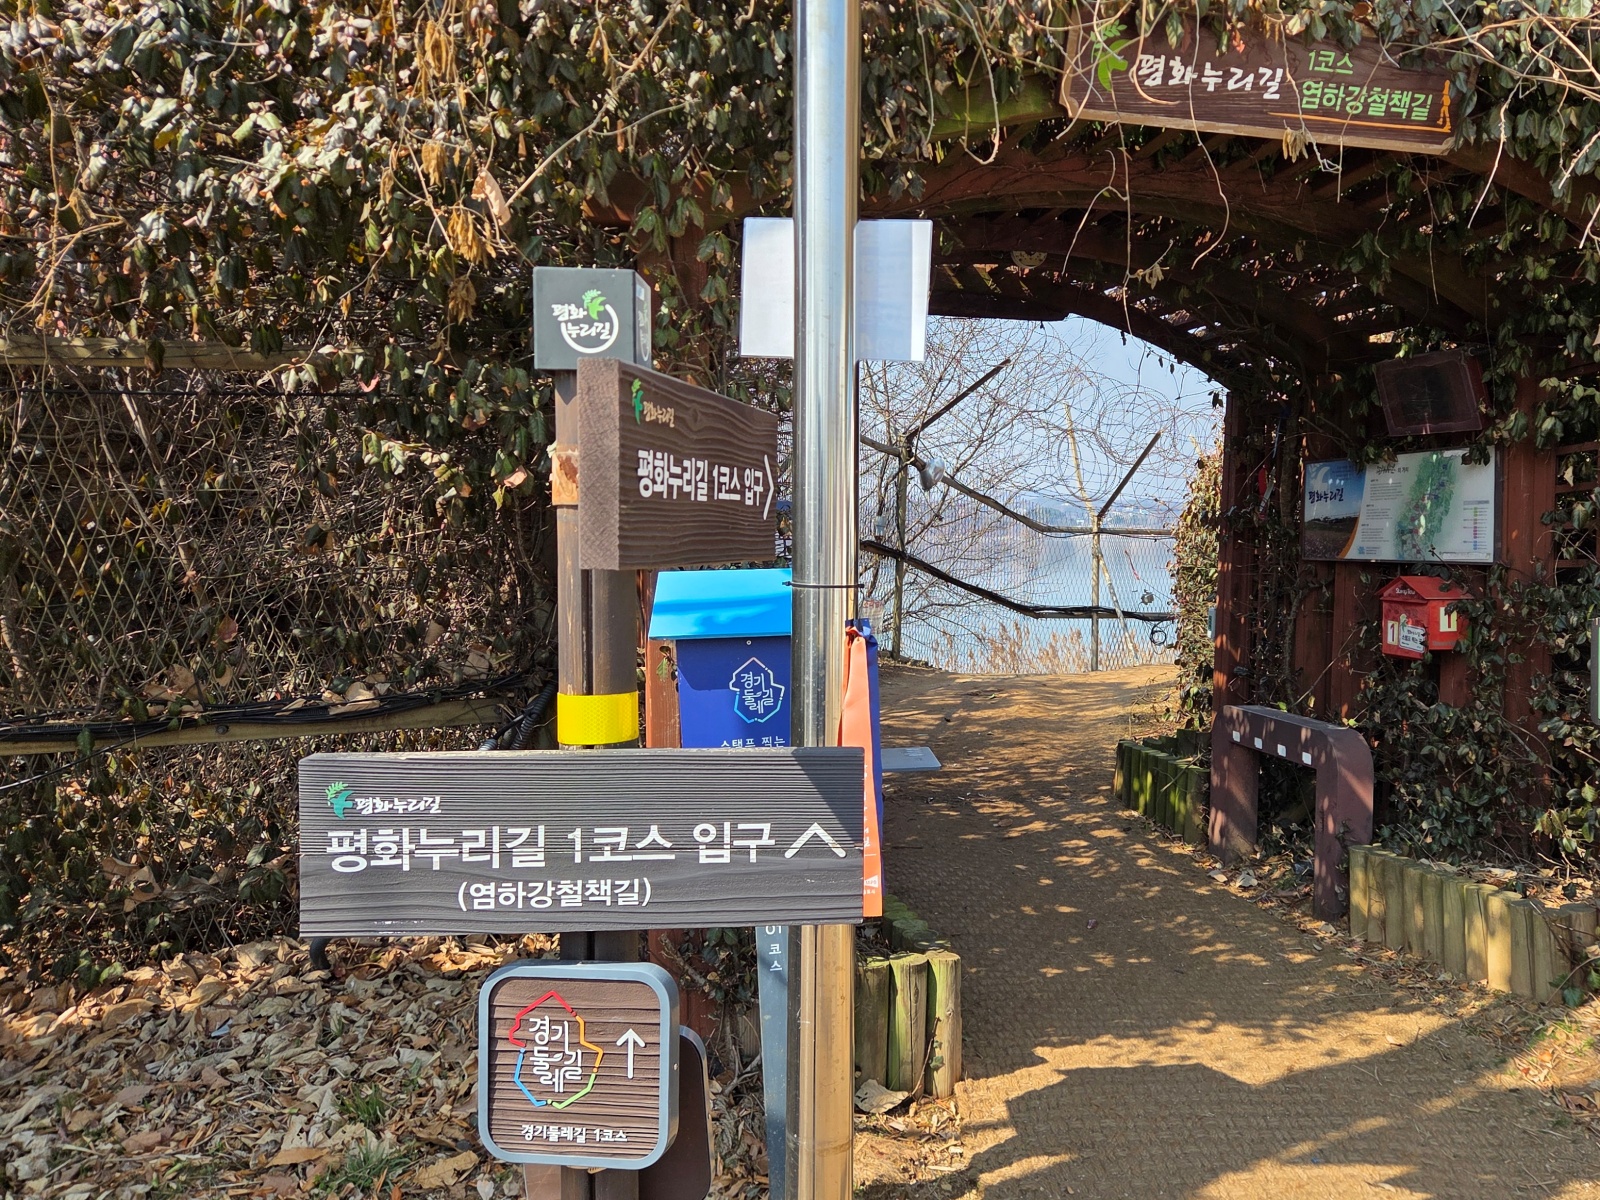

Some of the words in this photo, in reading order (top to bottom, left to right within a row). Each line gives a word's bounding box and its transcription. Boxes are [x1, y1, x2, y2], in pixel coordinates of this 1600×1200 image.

[1308, 50, 1354, 75] 1코스
[1137, 54, 1283, 100] 평화누리길
[1301, 80, 1433, 121] 염하강철책길
[551, 303, 587, 322] 평화
[565, 321, 611, 341] 누리길
[643, 402, 675, 427] 평화누리길
[637, 449, 709, 502] 평화누리길
[712, 465, 742, 501] 1코스
[743, 466, 764, 507] 입구
[1308, 488, 1344, 503] 평화누리길
[740, 671, 767, 692] 경기
[354, 796, 443, 815] 평화누리길
[326, 825, 546, 873] 평화누리길
[566, 824, 676, 864] 1코스
[693, 821, 776, 864] 입구
[457, 876, 653, 912] (염하강철책길)
[528, 1016, 570, 1055] 경기
[520, 1124, 587, 1144] 경기둘레길
[594, 1127, 629, 1143] 1코스
